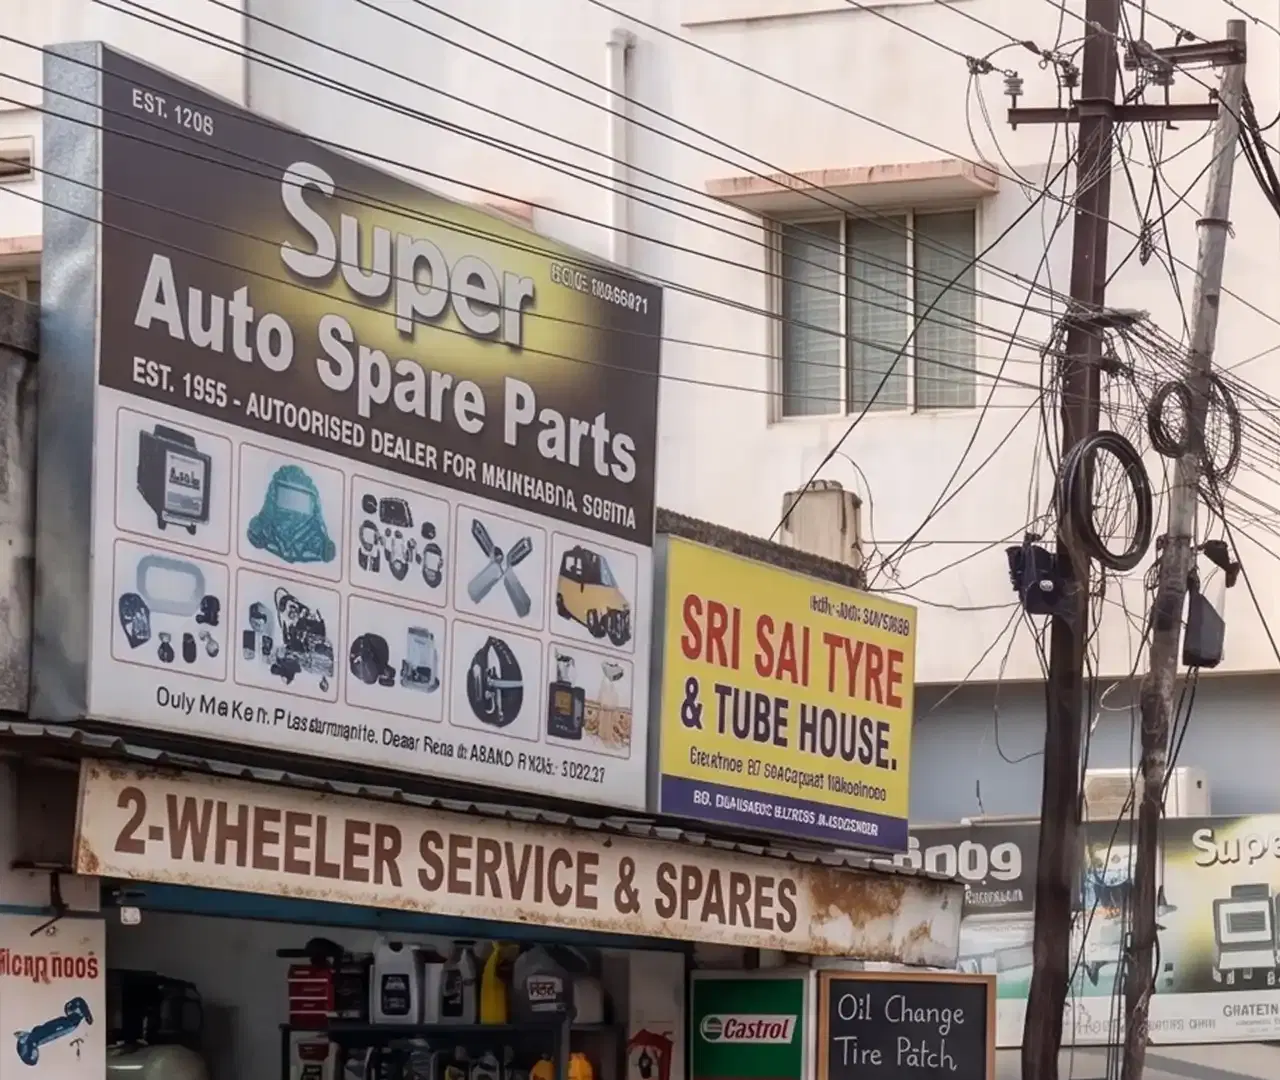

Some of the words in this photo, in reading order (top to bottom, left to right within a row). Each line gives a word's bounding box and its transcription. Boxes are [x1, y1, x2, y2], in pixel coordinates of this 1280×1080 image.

[132, 87, 168, 119] EST.
[280, 161, 536, 347] Super
[132, 356, 174, 393] EST.
[183, 372, 228, 408] 1955
[246, 392, 366, 448] AUTOORISED
[371, 427, 438, 471] DEALER
[443, 450, 477, 482] FOR
[134, 253, 294, 372] Auto
[316, 313, 486, 434] Spare
[504, 377, 637, 484] Parts
[681, 594, 741, 670] SRI
[754, 613, 810, 687] SAI
[823, 631, 904, 709] TYRE
[680, 676, 703, 731] &
[714, 683, 789, 748] TUBE
[799, 702, 898, 771] HOUSE.
[114, 786, 403, 887] 2-WHEELER
[418, 829, 600, 910] SERVICE
[614, 855, 641, 915] &
[655, 861, 797, 934] SPARES
[723, 1018, 789, 1040] Castrol
[833, 1036, 882, 1066] Tire
[837, 993, 872, 1021] Oil
[884, 994, 965, 1036] Change
